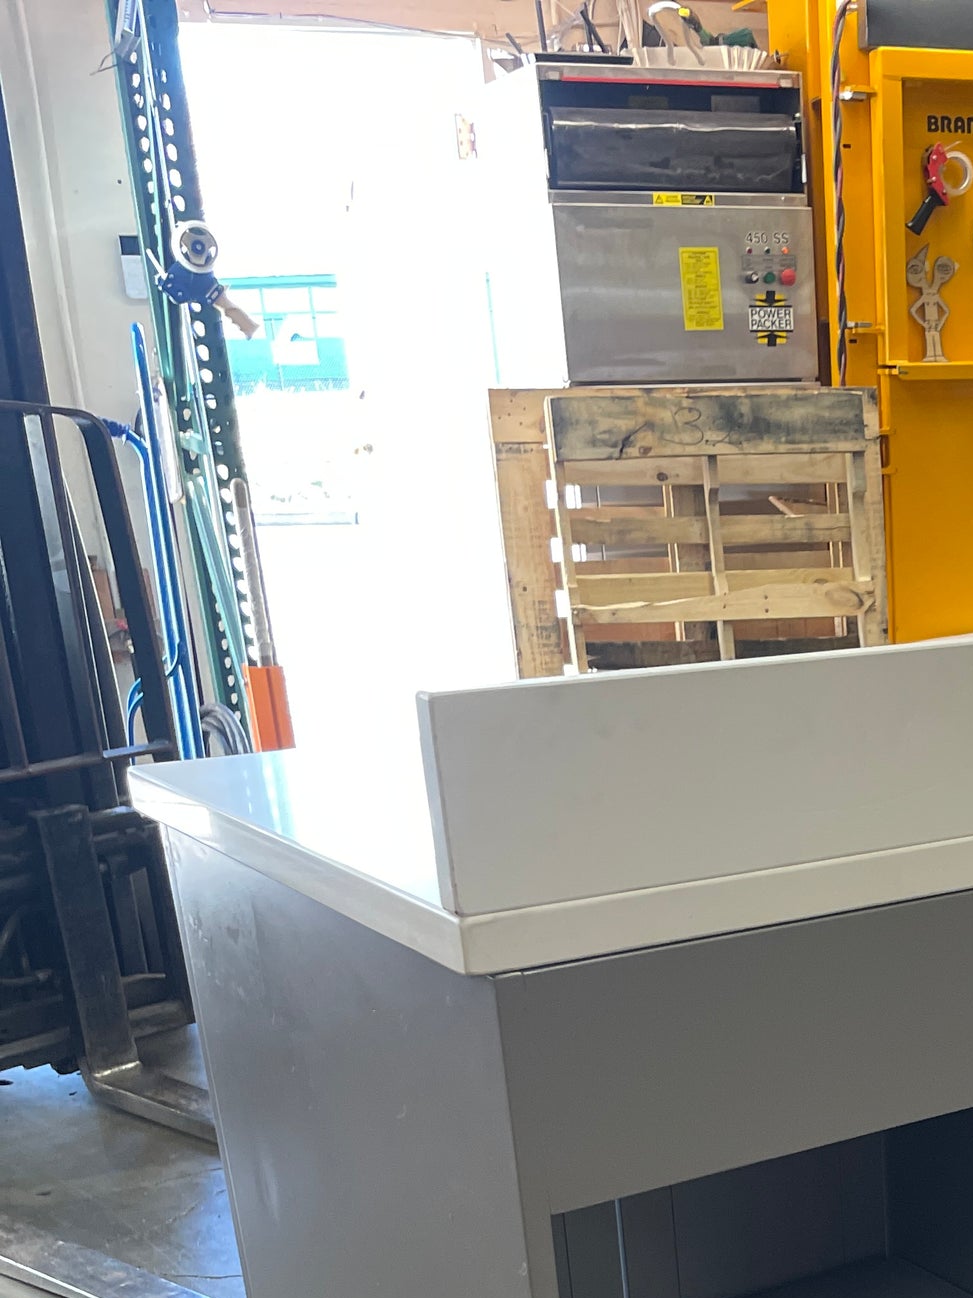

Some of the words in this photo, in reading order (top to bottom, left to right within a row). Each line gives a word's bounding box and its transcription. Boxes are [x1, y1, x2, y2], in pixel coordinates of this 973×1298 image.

[745, 232, 768, 245] 450
[773, 232, 789, 245] SS
[750, 308, 791, 319] POWER
[750, 318, 792, 329] PACKER
